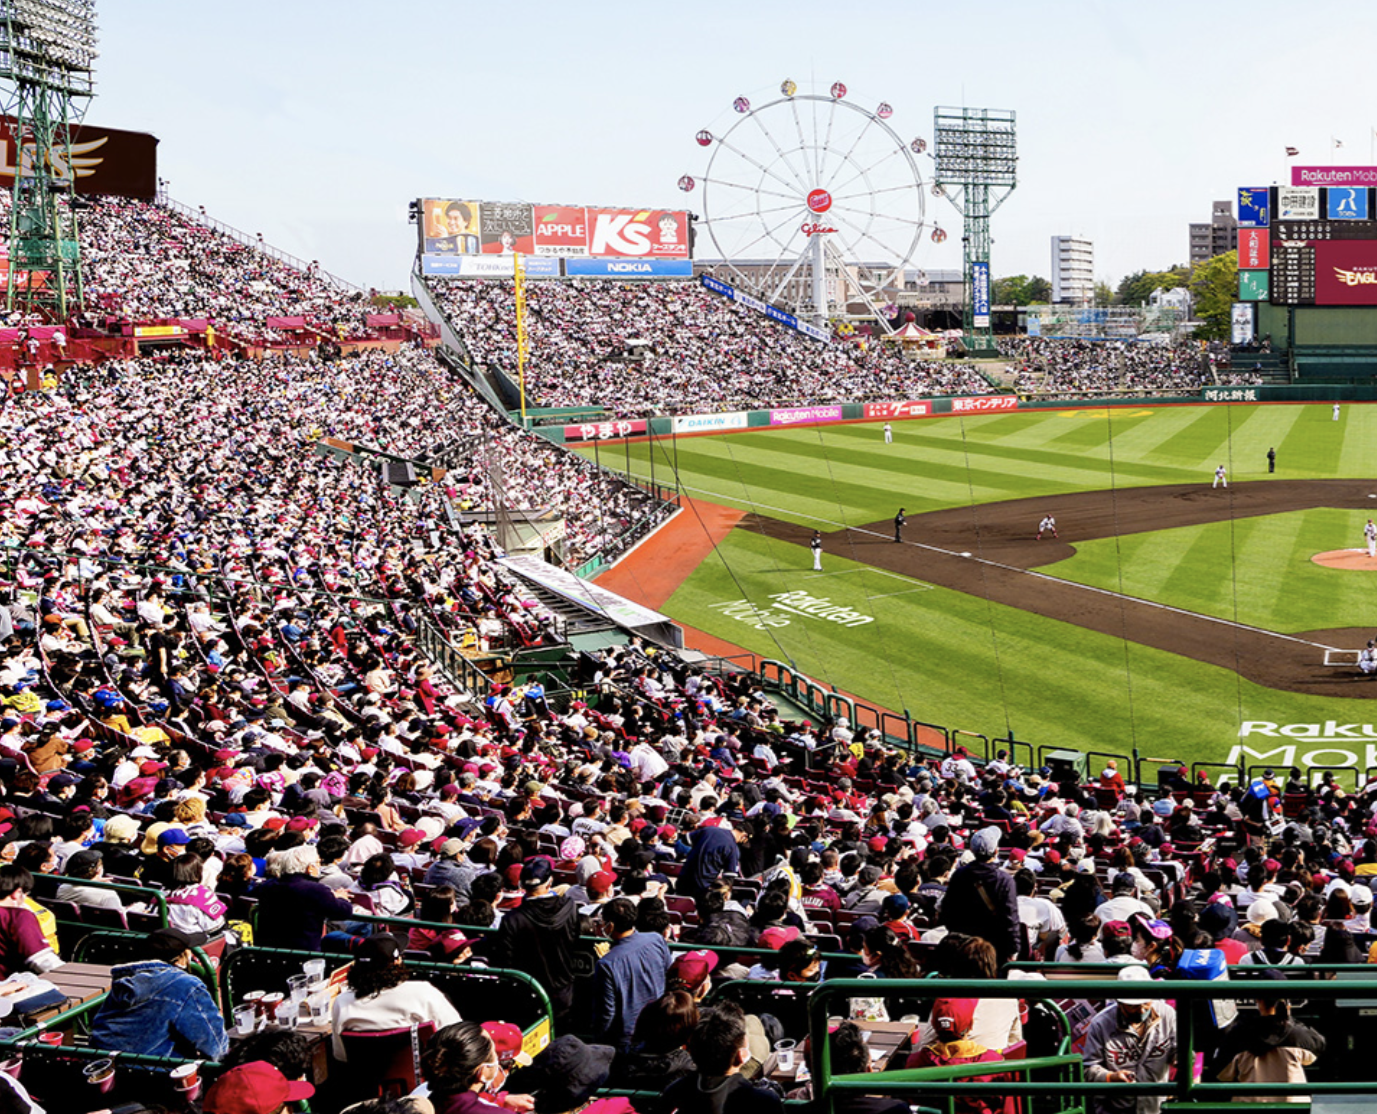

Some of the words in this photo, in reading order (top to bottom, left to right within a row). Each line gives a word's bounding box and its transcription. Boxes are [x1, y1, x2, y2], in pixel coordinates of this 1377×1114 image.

[1301, 169, 1352, 184] Rakuten
[537, 224, 586, 237] APPLE
[801, 222, 839, 238] Glico
[607, 263, 652, 272] NOKIA
[1205, 389, 1257, 402] 河北新報
[953, 396, 1017, 412] 東京インテリア
[688, 416, 725, 427] DAIKIN
[773, 408, 812, 424] Rakuten
[812, 406, 839, 418] Mobile
[580, 421, 632, 441] やまや
[768, 589, 875, 628] Rakuten
